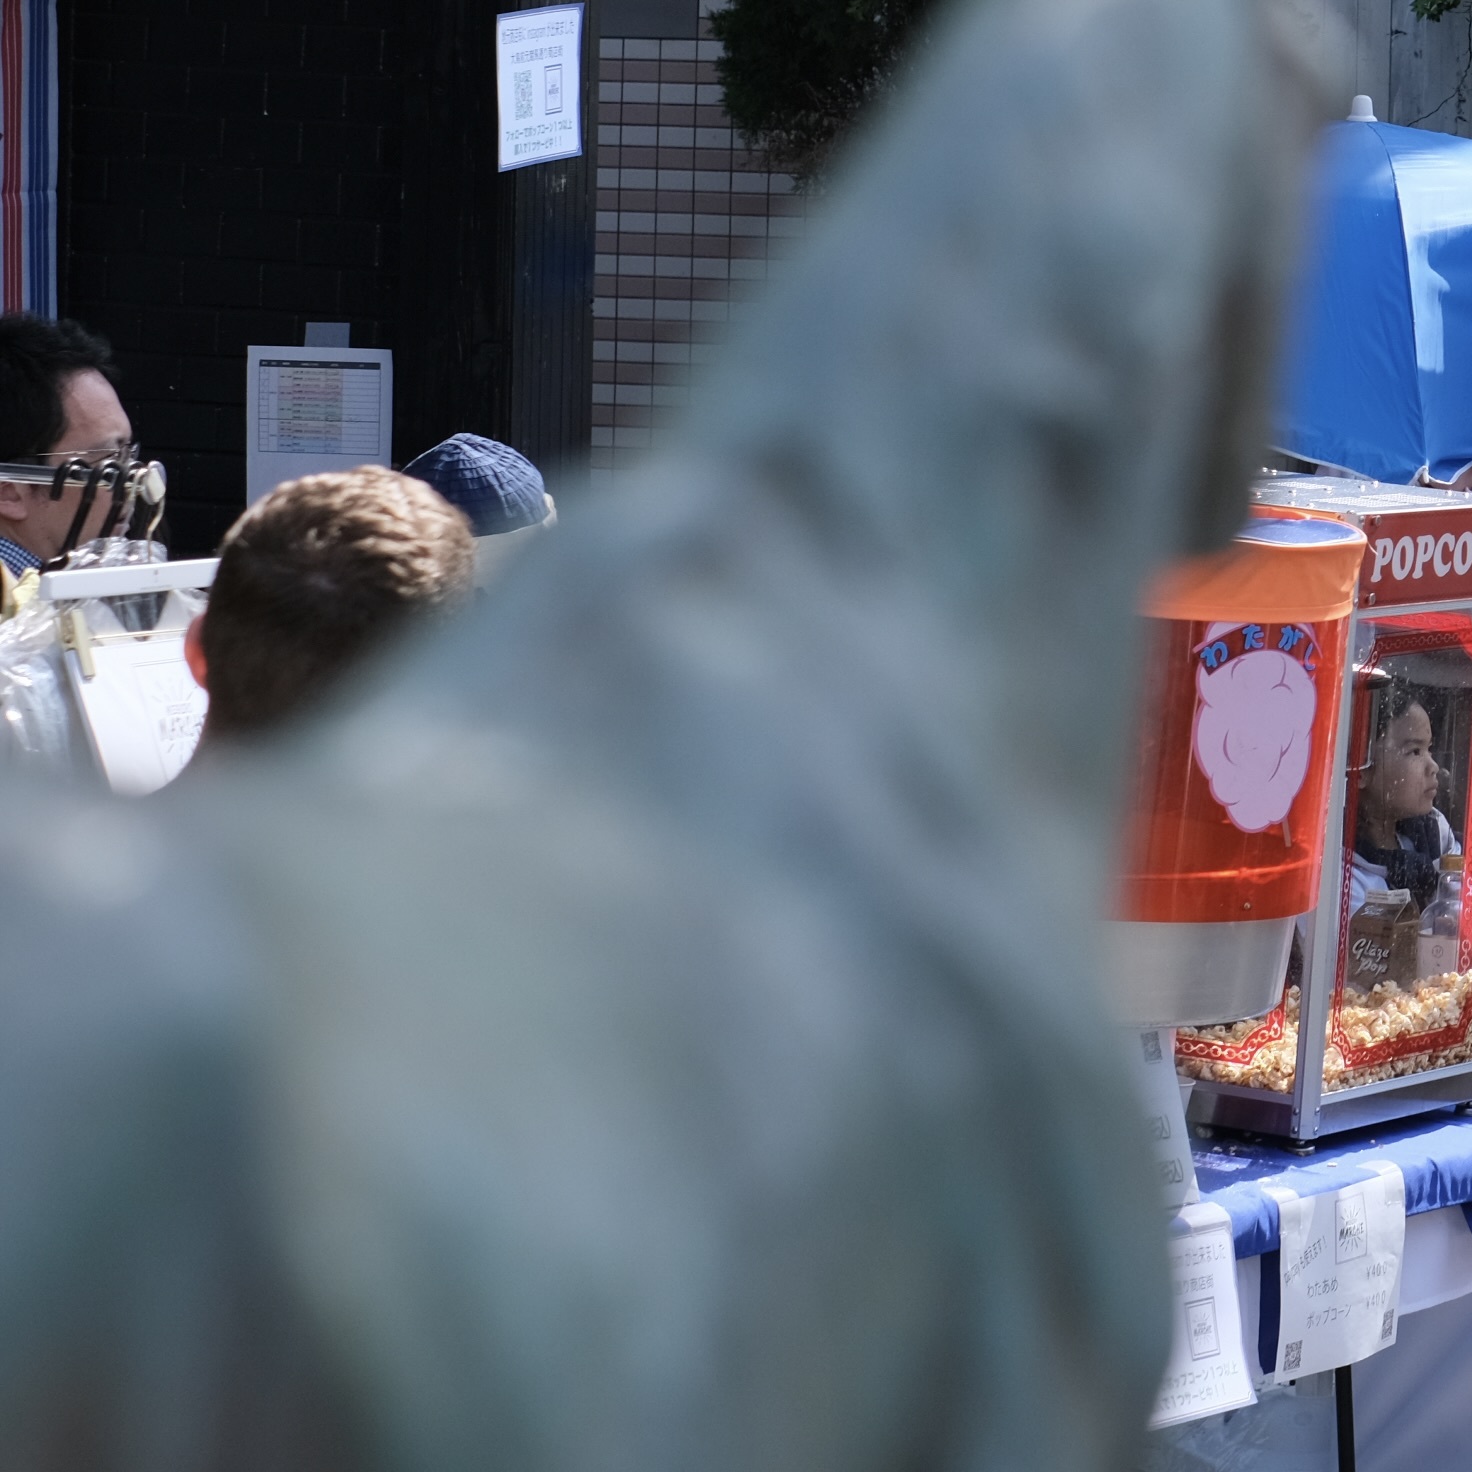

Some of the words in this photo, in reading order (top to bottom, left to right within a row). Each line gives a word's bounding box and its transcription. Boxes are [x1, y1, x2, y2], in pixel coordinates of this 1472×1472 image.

[1200, 624, 1316, 671] わたがし
[1307, 1277, 1339, 1299] わたあめ
[1366, 1260, 1388, 1280] ¥400
[1307, 1303, 1352, 1330] ポップコーン
[1366, 1290, 1387, 1309] ¥400
